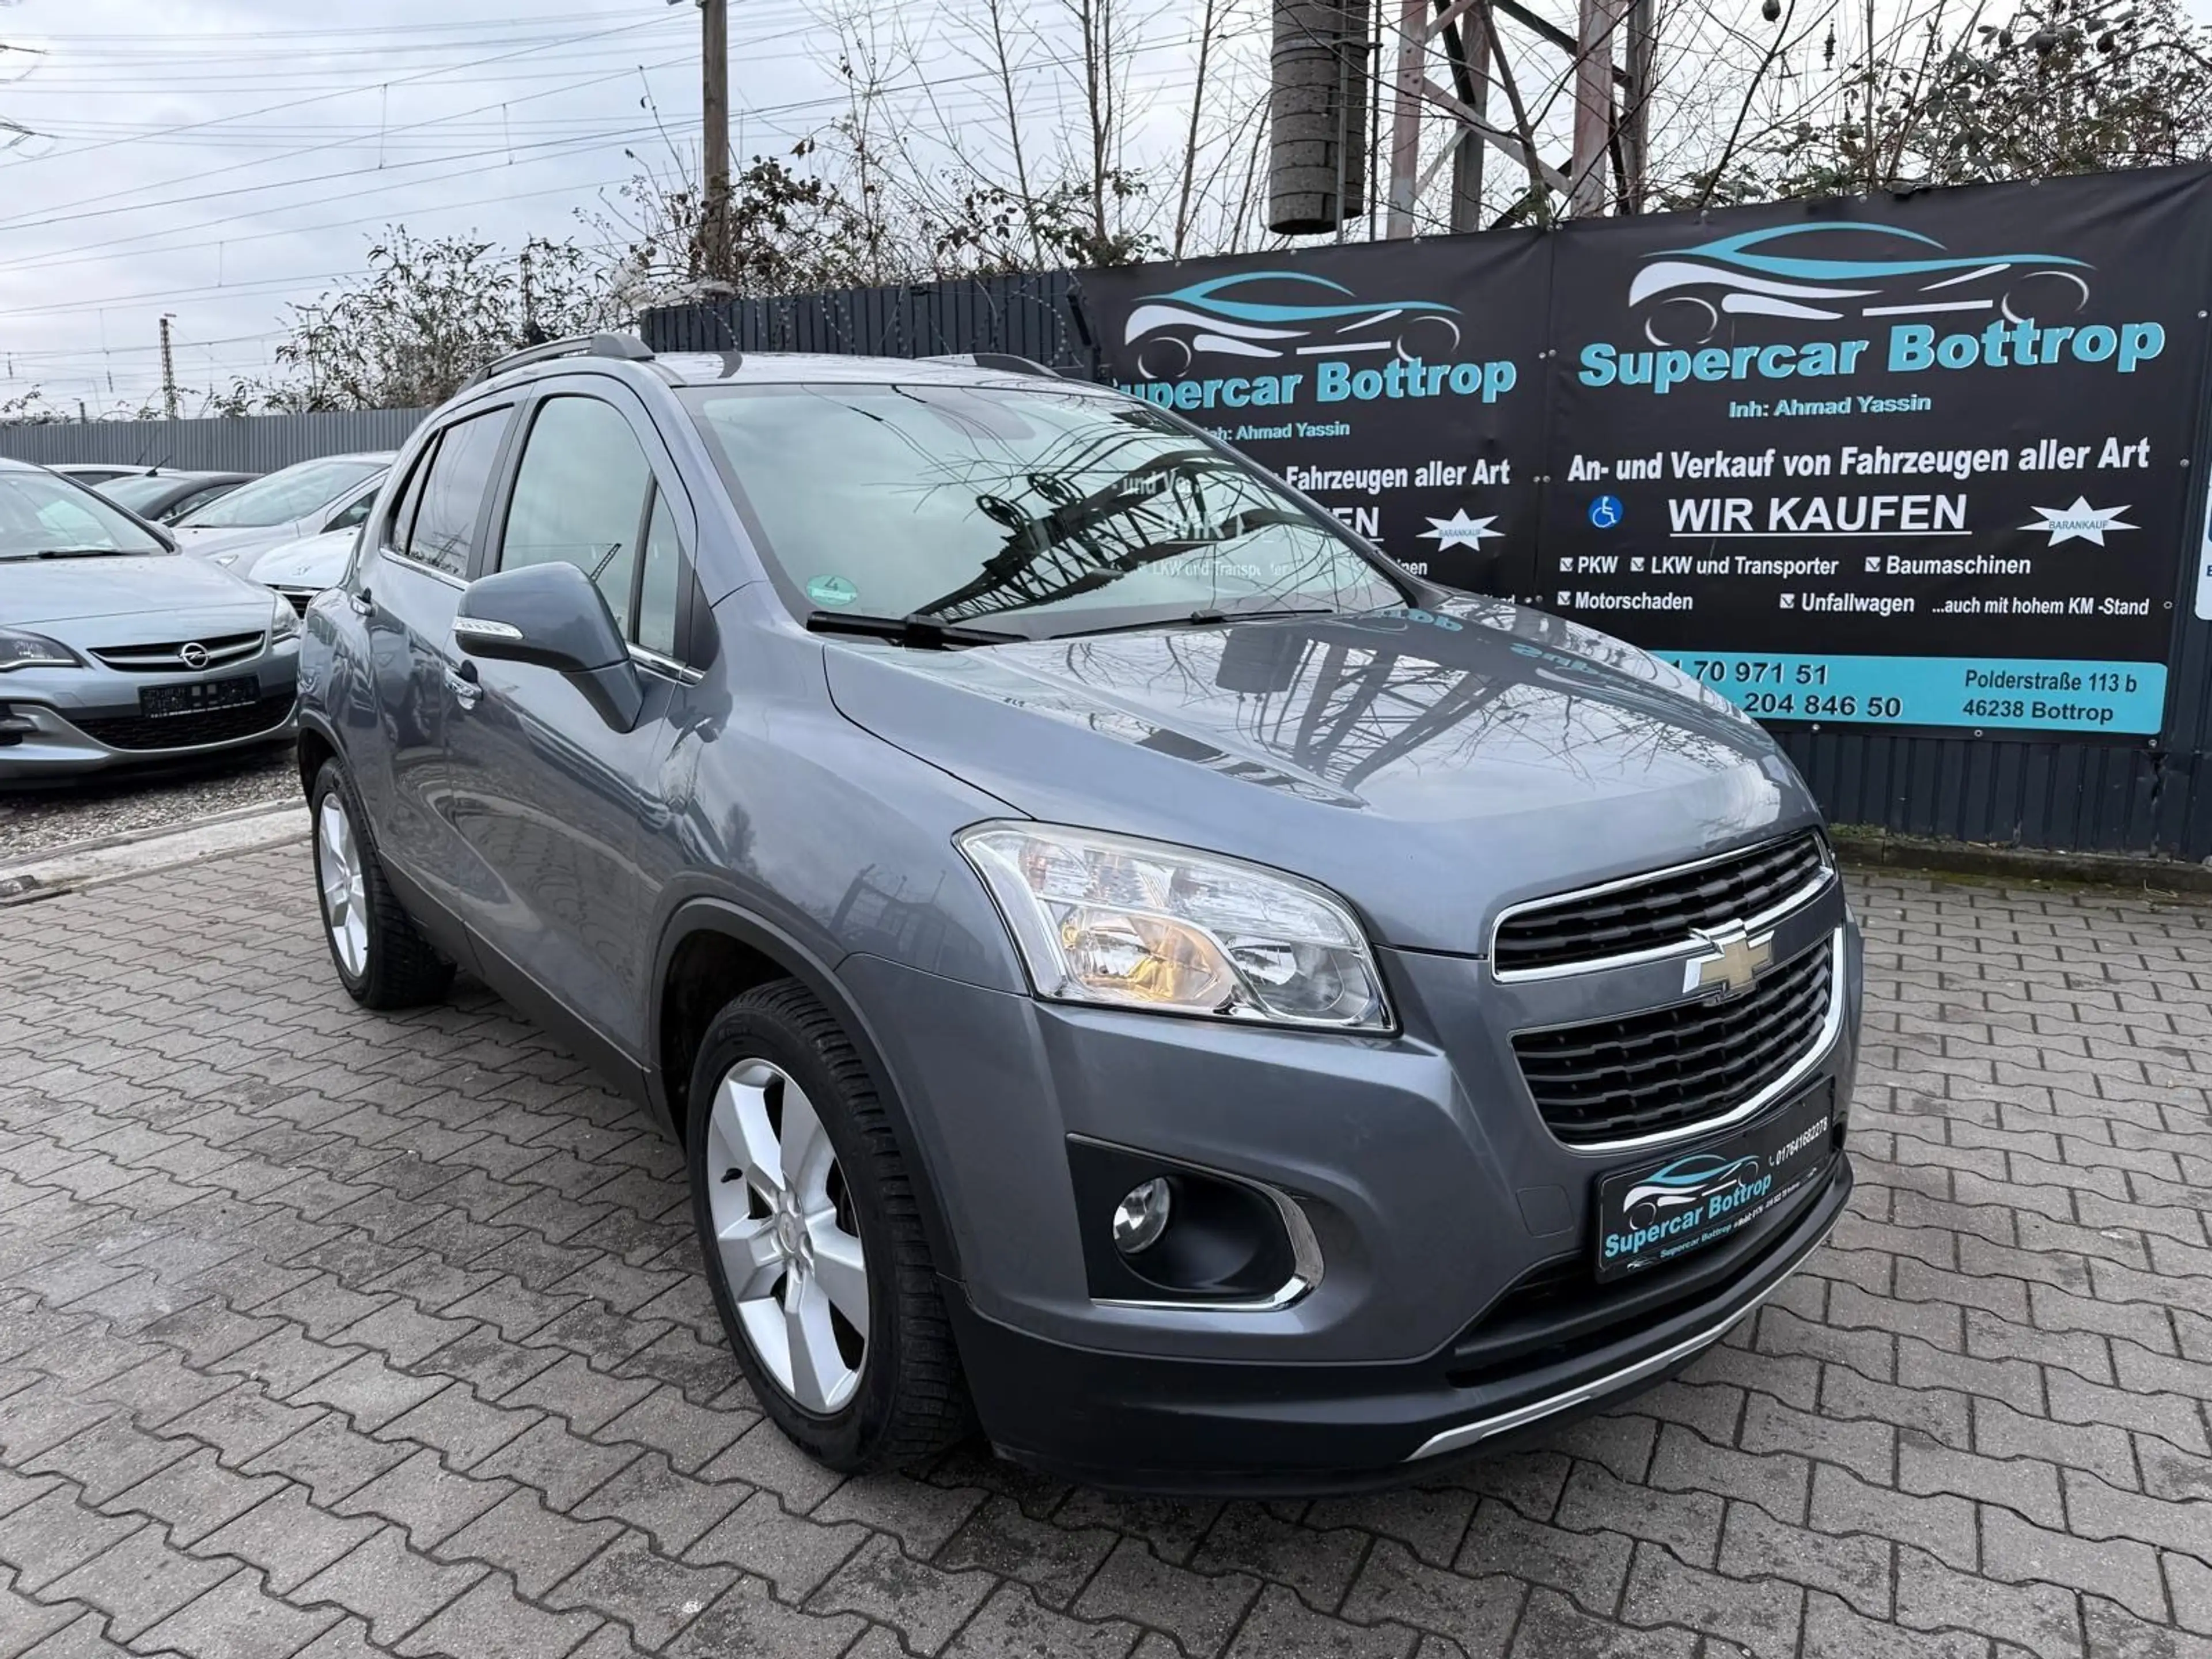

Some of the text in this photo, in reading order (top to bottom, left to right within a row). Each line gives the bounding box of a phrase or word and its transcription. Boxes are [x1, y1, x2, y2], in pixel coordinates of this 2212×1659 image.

[1578, 318, 2165, 394] Supercar Bottrop
[1113, 357, 1517, 410] upercar Bottrop
[1729, 393, 1931, 418] Inh: Ahmad Yassin
[1236, 423, 1292, 440] Ahmad
[1296, 421, 1350, 437] Yassin
[1568, 437, 2151, 482] An- und Verkauf von Fahrzeugen aller Art
[1286, 464, 1408, 495] Fahrzeugen
[1414, 461, 1467, 487] aller
[1472, 459, 1510, 485] Art
[1669, 494, 1967, 532] WIR KAUFEN
[2048, 520, 2108, 529] BARANKAUF
[1578, 555, 2031, 579] PKW LKW und Transporter Baumaschinen
[1575, 592, 1693, 610] Motorschaden
[1802, 593, 1915, 616] Unfallwagen
[1984, 597, 2009, 613] mit
[2012, 597, 2064, 614] hohem
[2068, 597, 2094, 614] KM
[2098, 597, 2150, 616] -Stand
[1693, 660, 1726, 681] 70
[1735, 661, 1784, 684] 971
[1795, 664, 1828, 685] 51
[1965, 669, 2137, 693] Polderstraße 113 b
[1743, 692, 1902, 718] 204 846 50
[1963, 699, 2113, 725] 46238 Bottrop
[1604, 1206, 1704, 1257] Supercar
[1708, 1173, 1772, 1219] Bottrop
